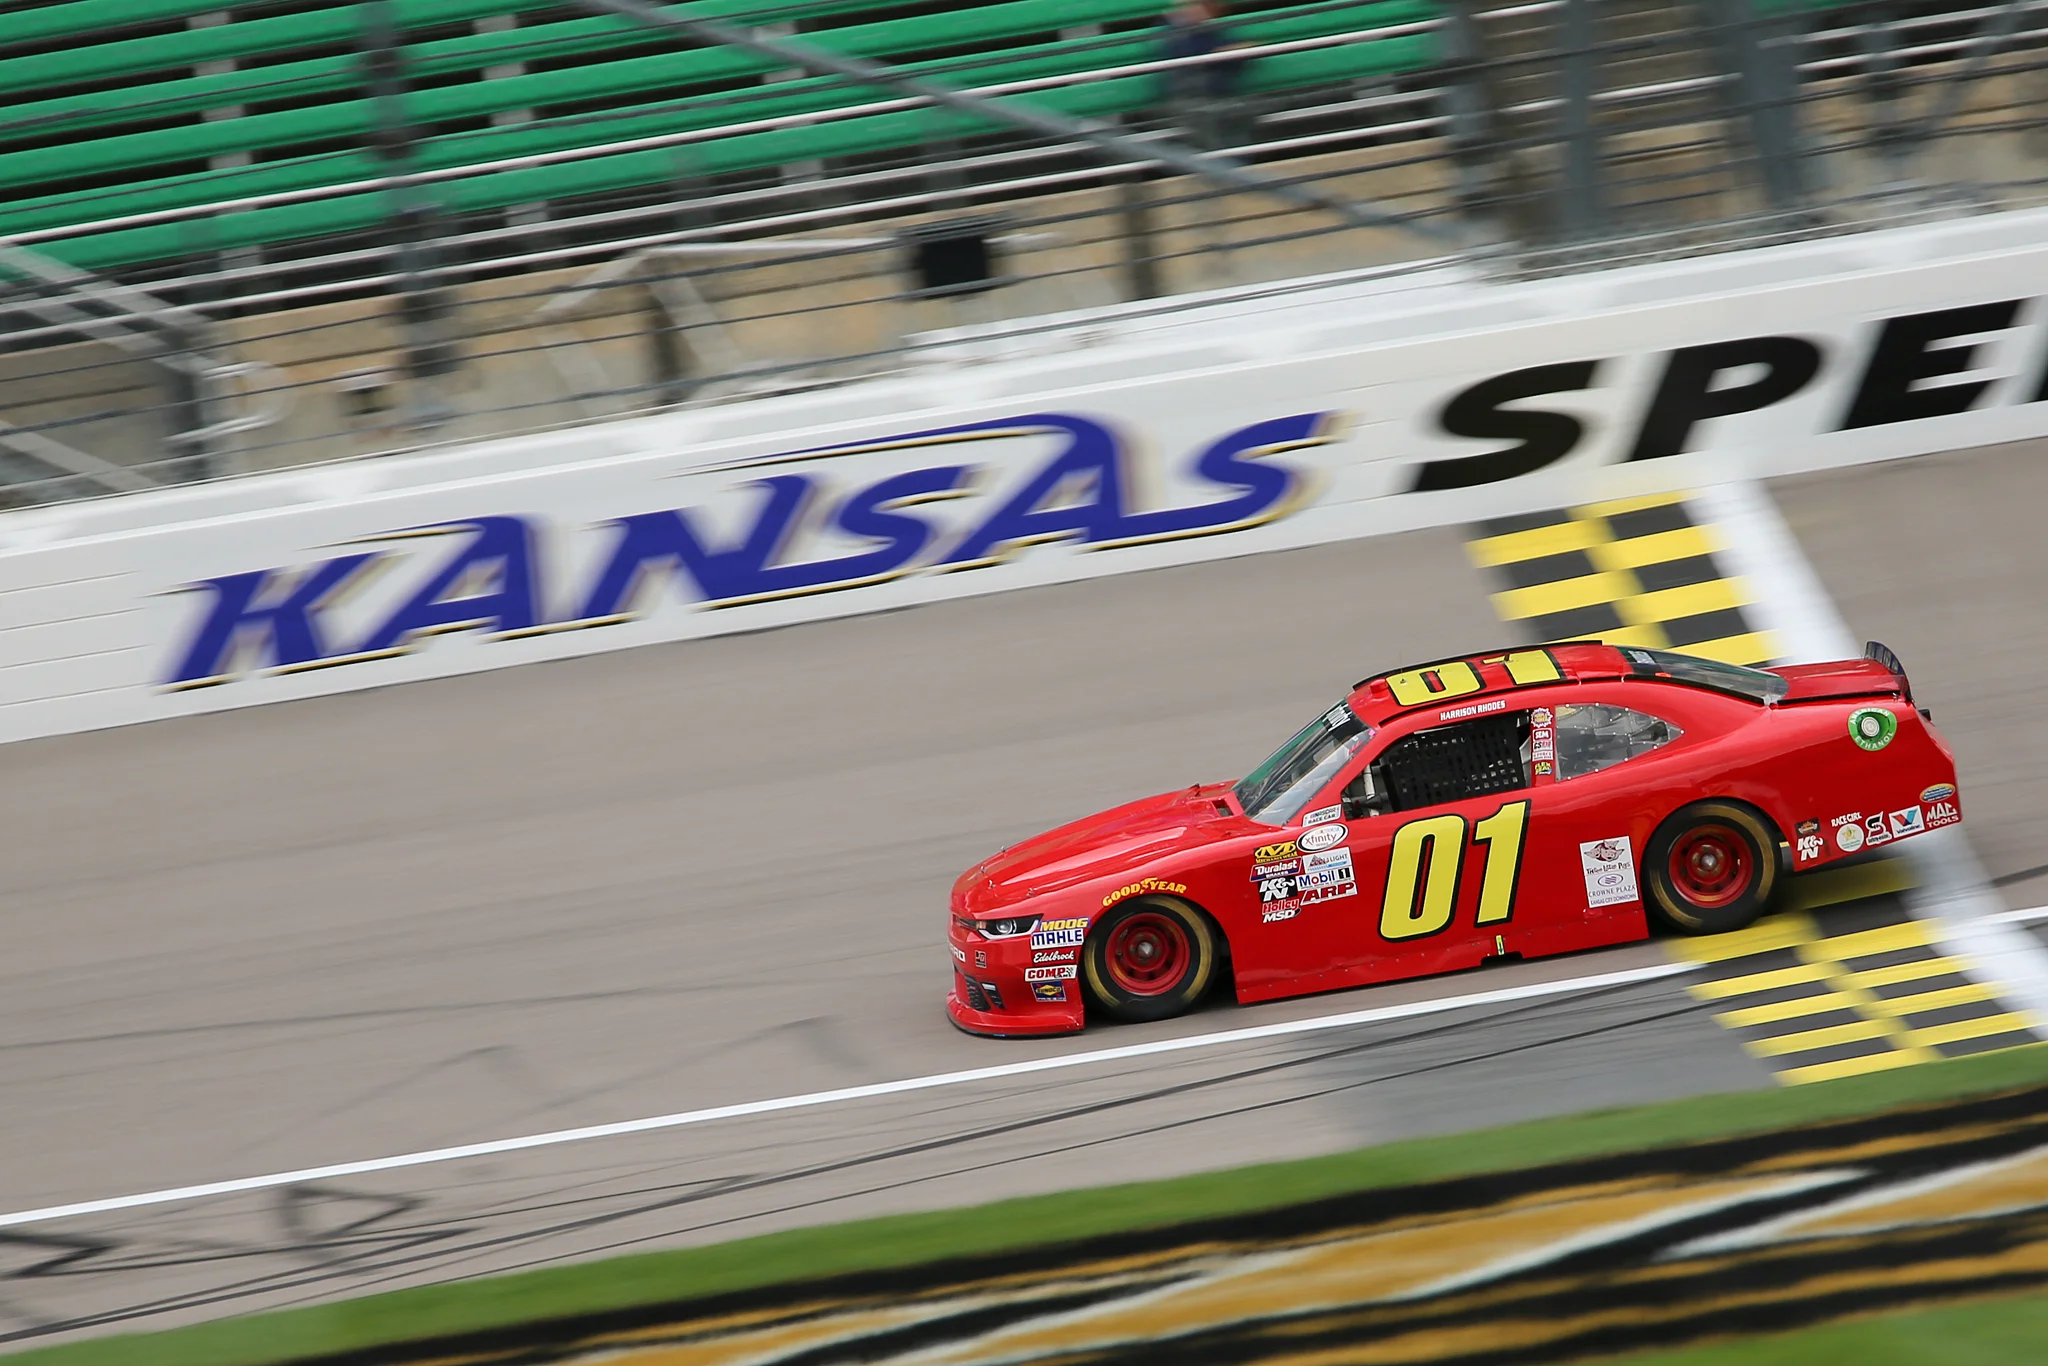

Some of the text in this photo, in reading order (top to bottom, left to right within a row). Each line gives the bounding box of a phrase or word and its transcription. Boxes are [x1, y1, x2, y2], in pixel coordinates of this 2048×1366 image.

[158, 297, 2048, 687] KANSAS SPE
[1386, 649, 1561, 706] 01
[1440, 700, 1506, 721] HARRISON RHODES
[1855, 732, 1894, 750] ETHANOL
[1323, 813, 1336, 821] CAR
[1926, 802, 1958, 822] MAC
[1926, 815, 1959, 828] TOOLS
[1305, 833, 1337, 846] xfinity
[1329, 853, 1348, 864] LIGHT
[1254, 859, 1298, 876] Duralast
[1379, 800, 1529, 941] 01
[1299, 869, 1336, 887] Mobil
[1302, 882, 1355, 903] ARP
[1588, 884, 1636, 898] CROWNE PLAZA
[1262, 899, 1300, 916] Holley
[1041, 917, 1089, 931] MOOG
[1263, 910, 1295, 924] MSD
[1032, 929, 1083, 946] MAHLE
[1033, 950, 1075, 964] Edelbrock
[1027, 967, 1066, 979] COMP
[1036, 985, 1062, 994] SUNOCO
